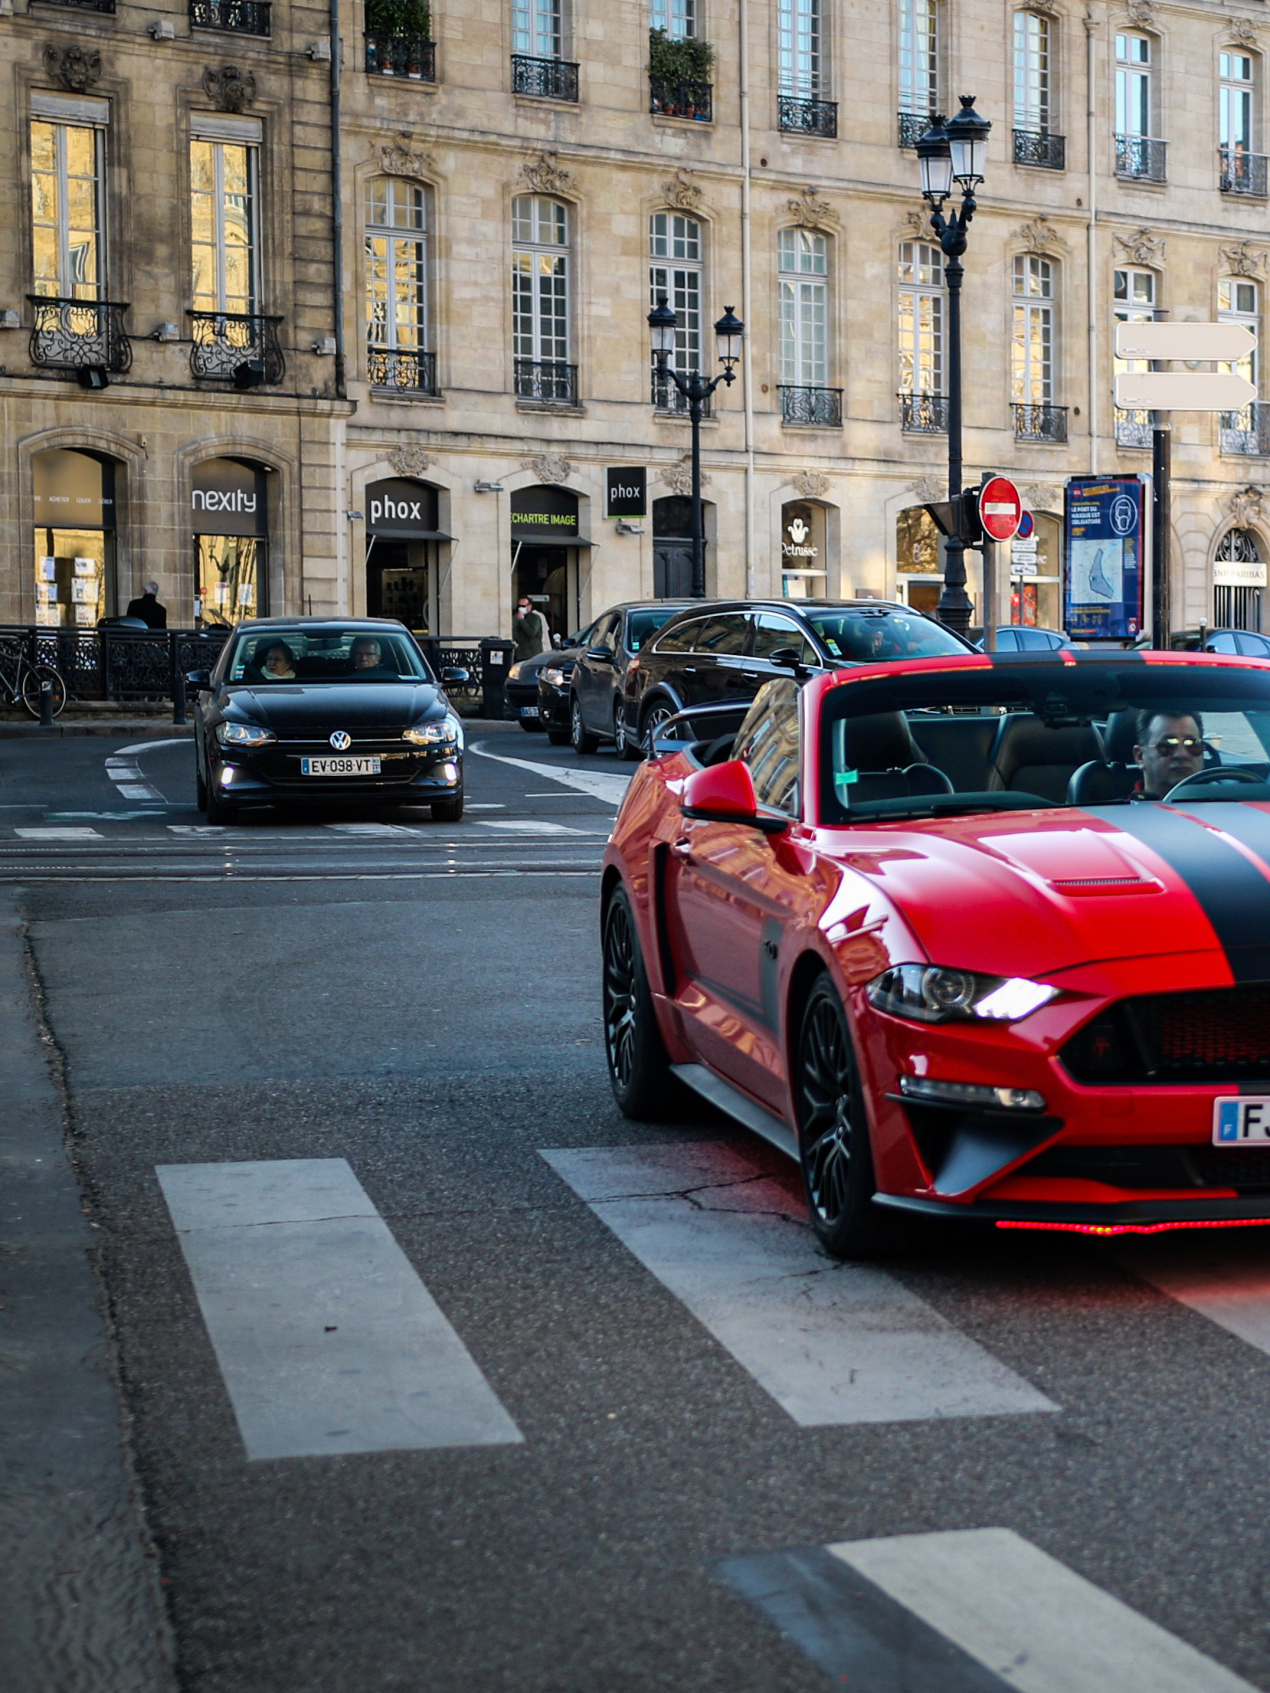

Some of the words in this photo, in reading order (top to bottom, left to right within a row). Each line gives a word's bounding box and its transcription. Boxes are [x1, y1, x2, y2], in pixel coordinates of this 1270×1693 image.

[610, 484, 640, 502] phox
[192, 489, 256, 513] nexity
[370, 495, 421, 524] phox
[511, 512, 549, 524] CHARTRE
[550, 514, 576, 526] IMAGE
[1231, 569, 1265, 579] PARIBAS
[312, 760, 371, 772] EV-098-VT
[1224, 1124, 1232, 1135] F
